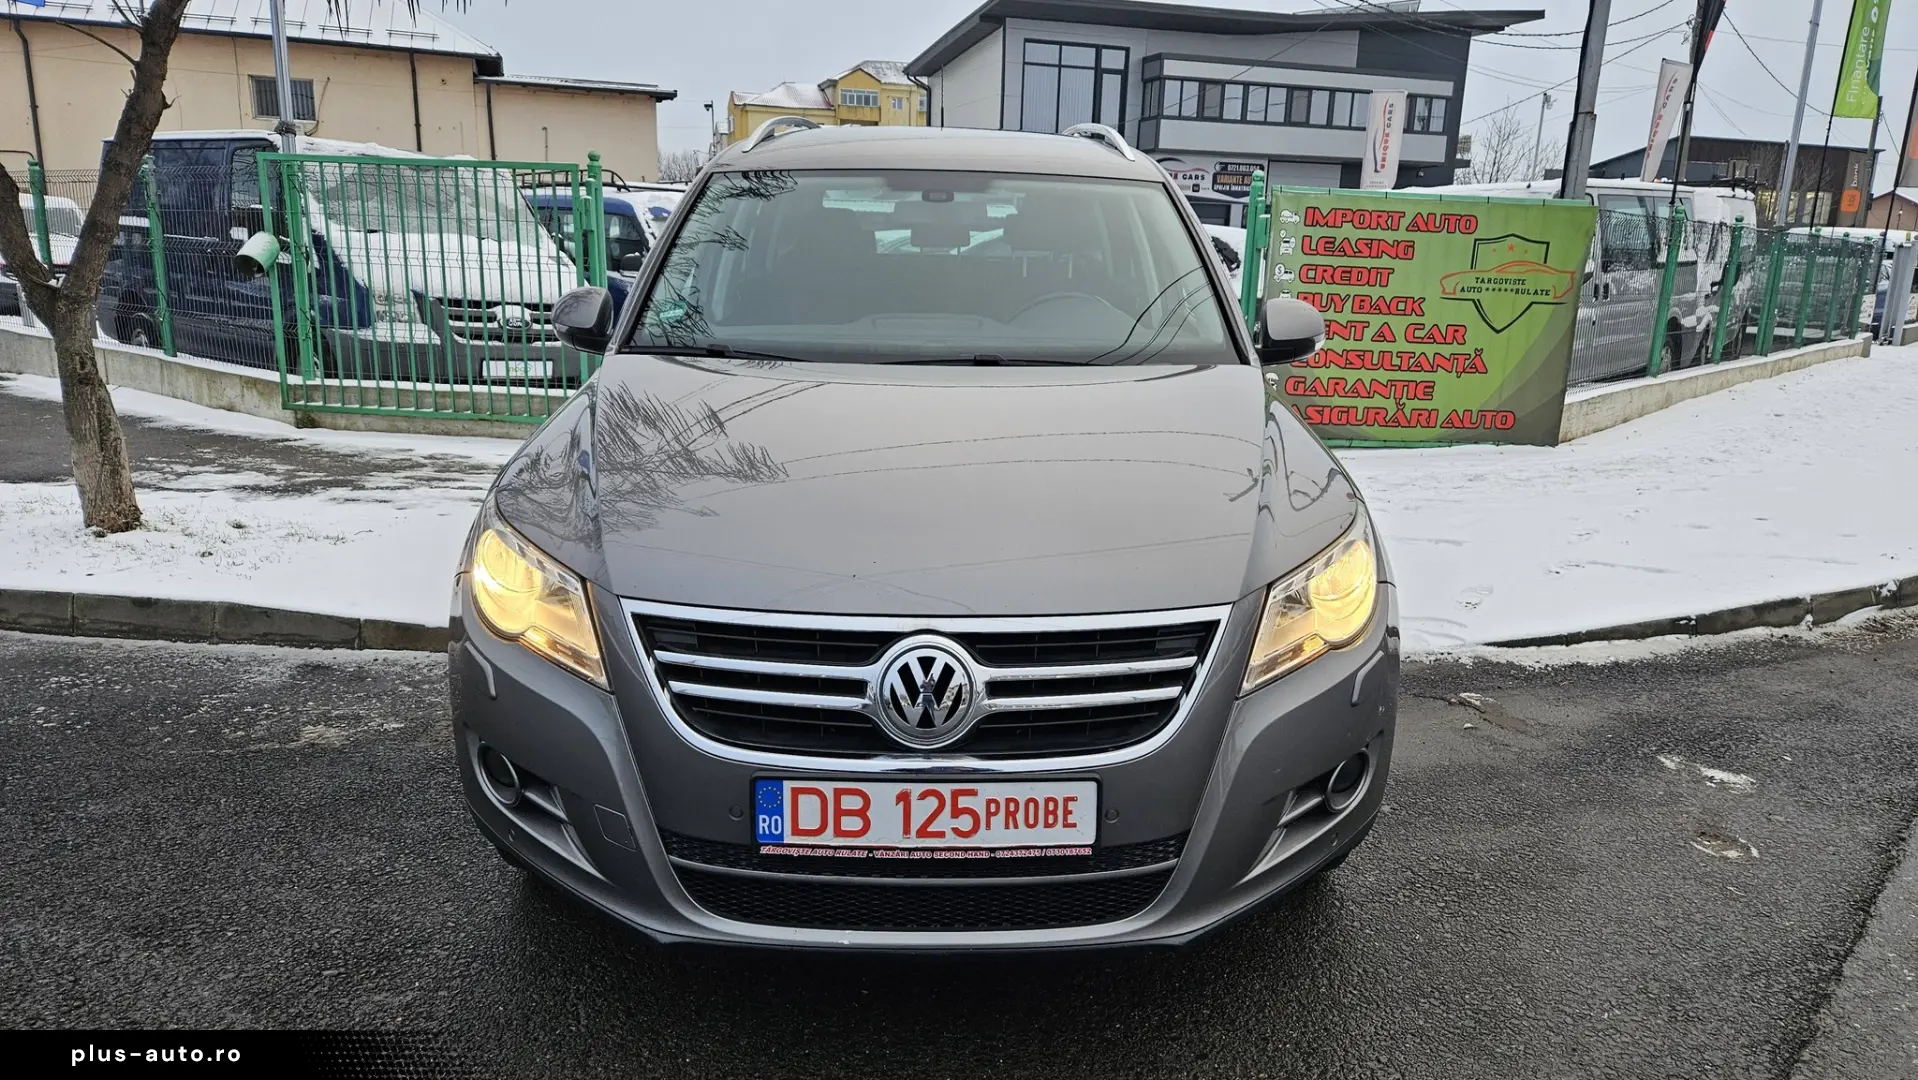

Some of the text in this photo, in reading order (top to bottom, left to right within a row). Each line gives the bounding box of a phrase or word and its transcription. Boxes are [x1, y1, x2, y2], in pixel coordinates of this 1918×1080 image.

[1379, 103, 1394, 170] UNIQUE CARS
[1181, 173, 1206, 181] CARS
[1850, 163, 1859, 187] bank
[1304, 206, 1478, 234] IMPORT AUTO
[1301, 235, 1415, 260] LEASING
[1299, 263, 1394, 287] CREDIT
[1475, 276, 1527, 286] TARGOVISTE
[1514, 288, 1551, 296] RULATE
[1351, 294, 1426, 317] BACK
[1324, 320, 1468, 346] NT A CAR
[1290, 348, 1488, 378] ONSULTANȚĂ
[1284, 376, 1435, 404] GARANȚIE
[1440, 408, 1516, 430] AUTO
[790, 786, 1079, 839] DB 125 PROBE
[758, 815, 782, 835] RO
[811, 848, 835, 857] AUTO
[834, 848, 868, 858] RULATE
[910, 850, 932, 859] AUTO
